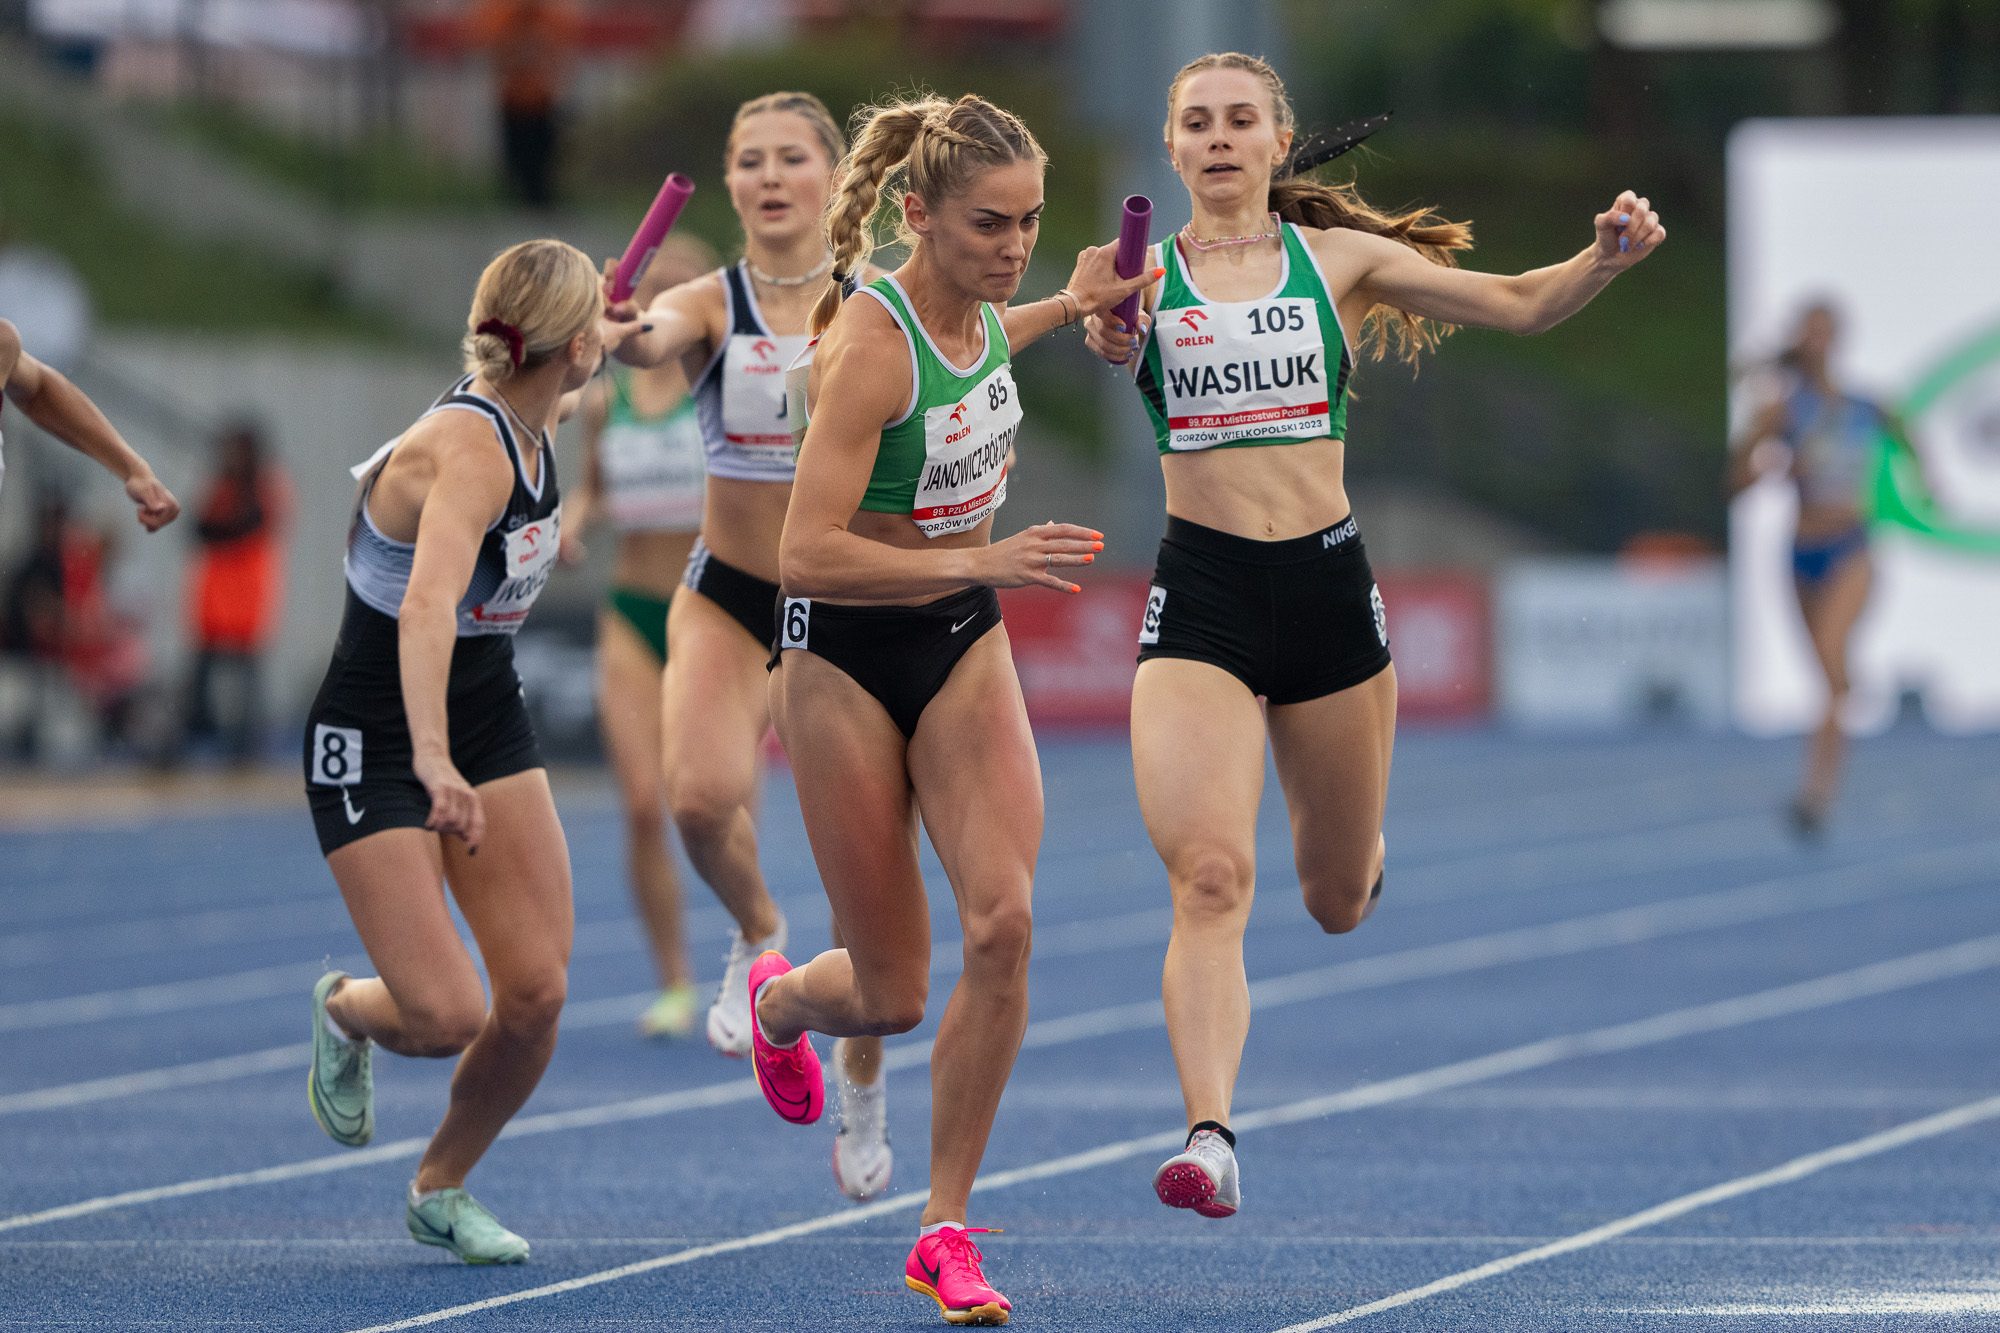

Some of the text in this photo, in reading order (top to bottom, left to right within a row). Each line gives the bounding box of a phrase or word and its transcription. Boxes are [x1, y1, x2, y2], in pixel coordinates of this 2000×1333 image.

[1247, 305, 1304, 335] 105
[1175, 335, 1214, 348] ORLEN
[1168, 353, 1320, 399] WASILUK
[987, 376, 1008, 412] 85
[1188, 406, 1309, 427] 99. PZLA Mistrzostwa Polski
[945, 424, 971, 445] ORLEN
[1176, 419, 1323, 443] GORZÓW WIELKOPOLSKI 2023
[932, 508, 946, 517] 99.
[948, 506, 968, 515] PZLA
[968, 490, 995, 511] Mistrzos
[919, 519, 962, 532] GORZÓW
[1322, 519, 1356, 549] NIKE
[787, 601, 807, 643] 6
[321, 731, 348, 780] 8
